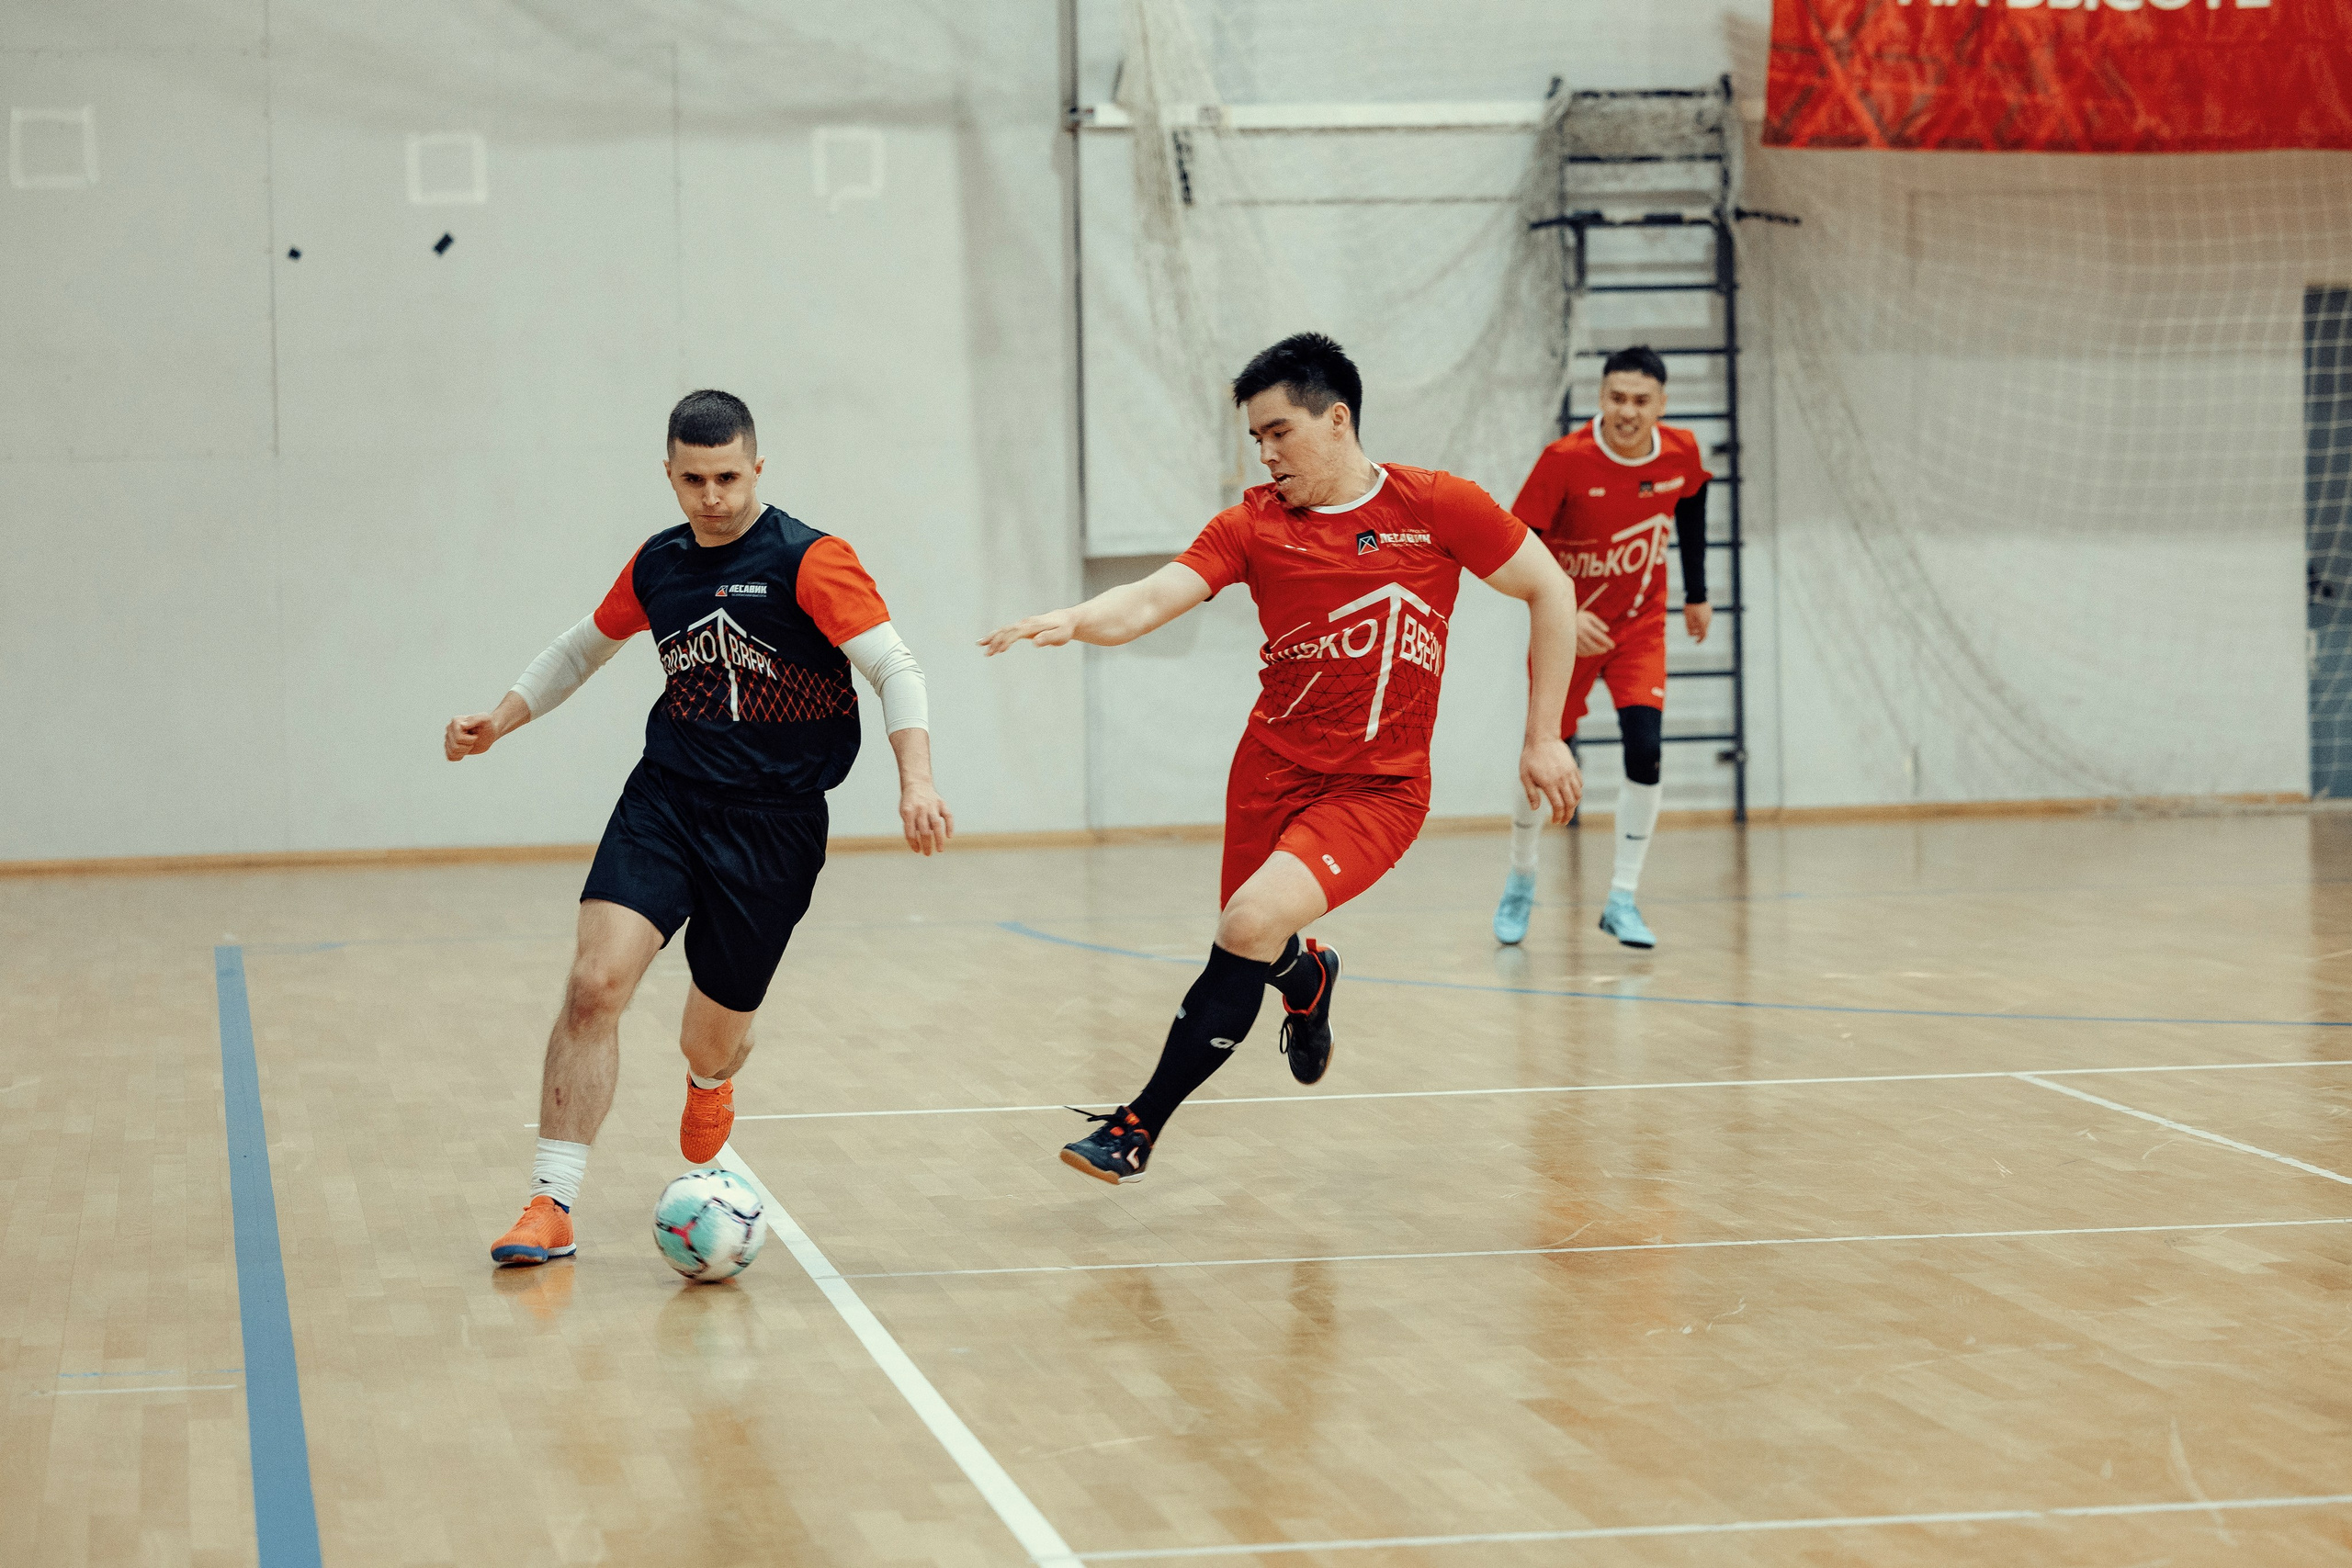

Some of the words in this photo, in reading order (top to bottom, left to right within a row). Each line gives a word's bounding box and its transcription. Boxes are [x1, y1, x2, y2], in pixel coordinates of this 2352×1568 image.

[1559, 537, 1650, 579] ОЛЬКО
[729, 584, 767, 594] ЛЕСАВИК
[661, 630, 717, 676] ОЛЬКО
